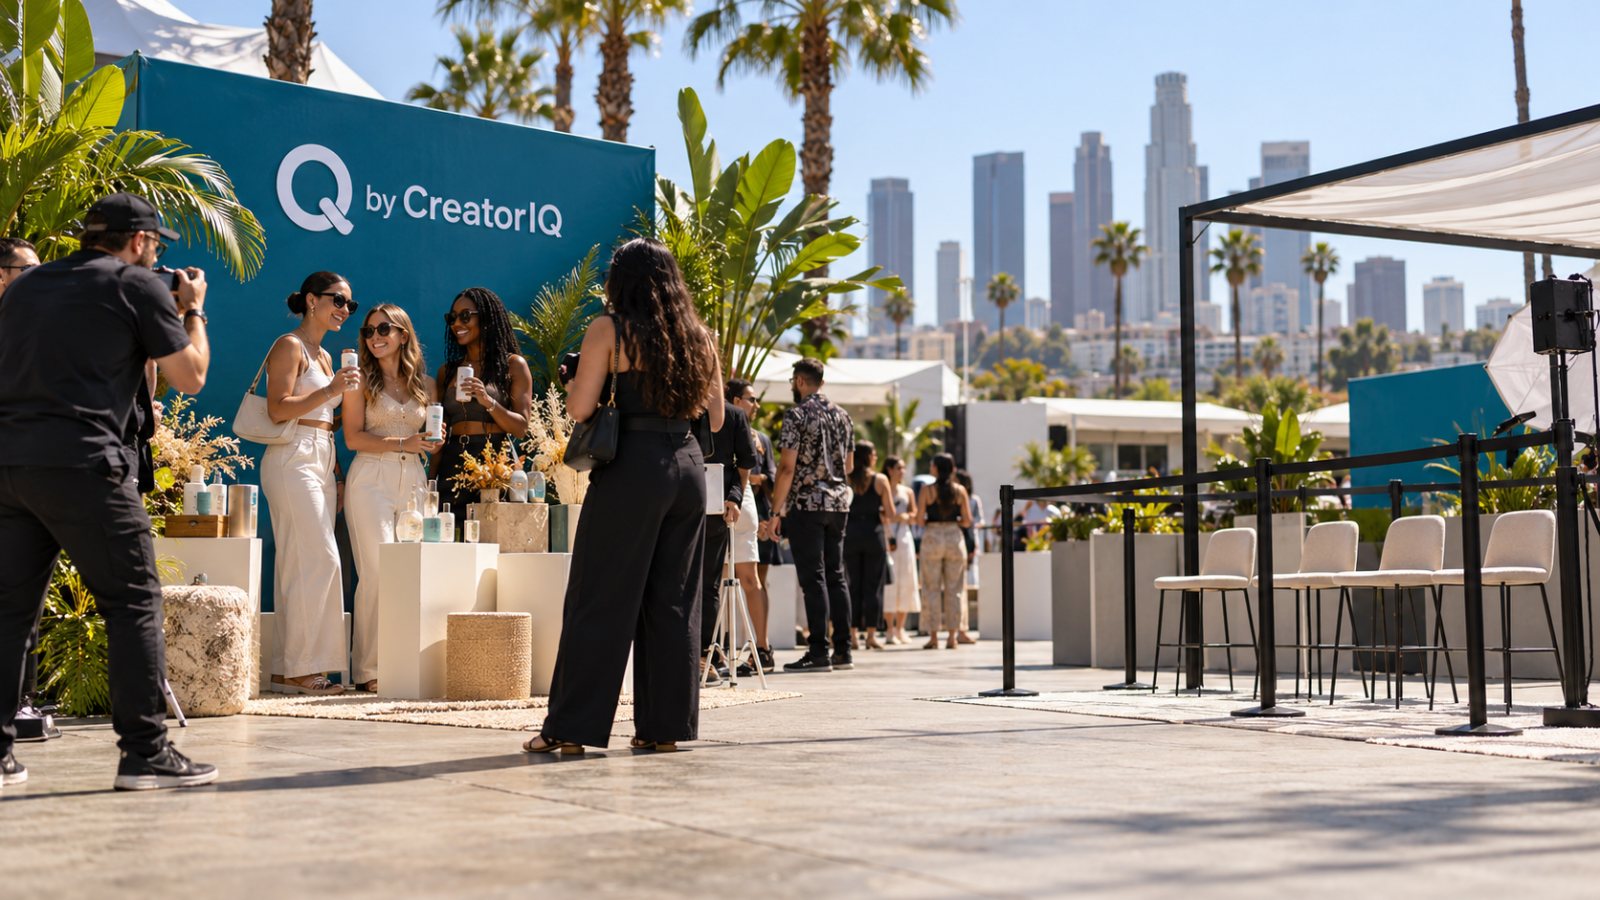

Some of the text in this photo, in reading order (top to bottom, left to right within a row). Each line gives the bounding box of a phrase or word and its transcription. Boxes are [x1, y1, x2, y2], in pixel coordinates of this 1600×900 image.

[276, 143, 563, 238] Q by CreatorIQ
